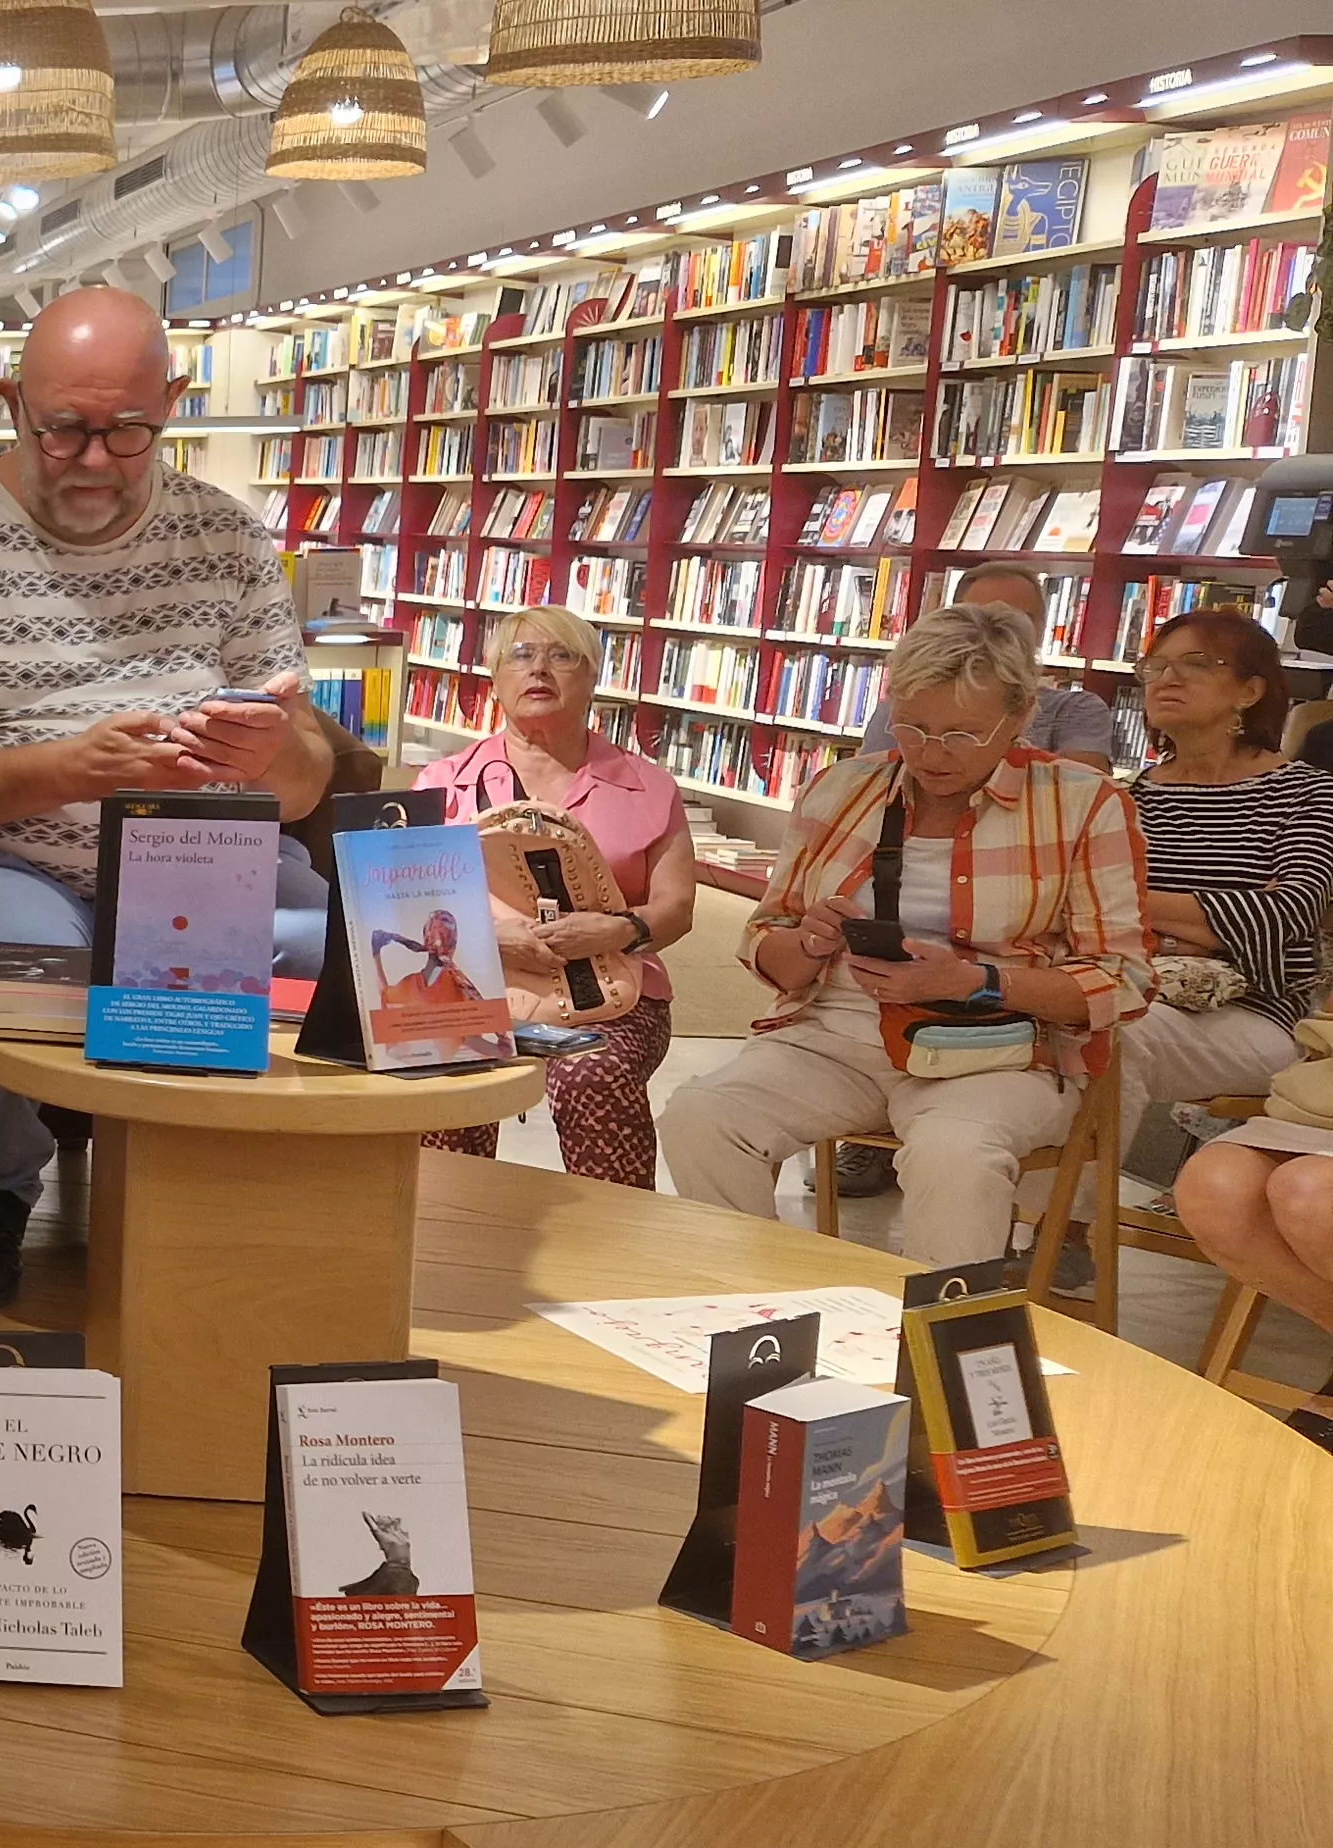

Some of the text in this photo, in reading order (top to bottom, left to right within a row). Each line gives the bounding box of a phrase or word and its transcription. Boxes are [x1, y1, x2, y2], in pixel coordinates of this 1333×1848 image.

[1149, 69, 1193, 93] HISTORIA
[129, 829, 263, 848] Sergio del Molino
[129, 850, 214, 865] La hora violeta
[385, 891, 410, 900] HASTA
[412, 890, 422, 898] LA
[5, 1418, 28, 1433] EL
[299, 1433, 395, 1448] Rosa Montero
[768, 1421, 780, 1456] MANN
[14, 1442, 102, 1465] NEGRO
[302, 1453, 396, 1467] La ridícula idea
[813, 1445, 853, 1463] THOMAS
[811, 1461, 843, 1477] MANN
[303, 1472, 422, 1487] de no volver a verte
[810, 1479, 822, 1491] La
[34, 1585, 49, 1594] DE
[53, 1586, 67, 1595] LO
[15, 1598, 86, 1610] IMPROBABLE
[337, 1604, 347, 1612] es
[349, 1603, 361, 1611] un
[362, 1602, 383, 1611] libro
[385, 1602, 409, 1611] sobre
[411, 1601, 420, 1610] la
[310, 1611, 363, 1622] apasionado
[364, 1613, 370, 1622] y
[404, 1610, 455, 1620] sentimental
[60, 1621, 103, 1638] Taleb
[310, 1623, 317, 1632] y
[358, 1621, 384, 1630] ROSA
